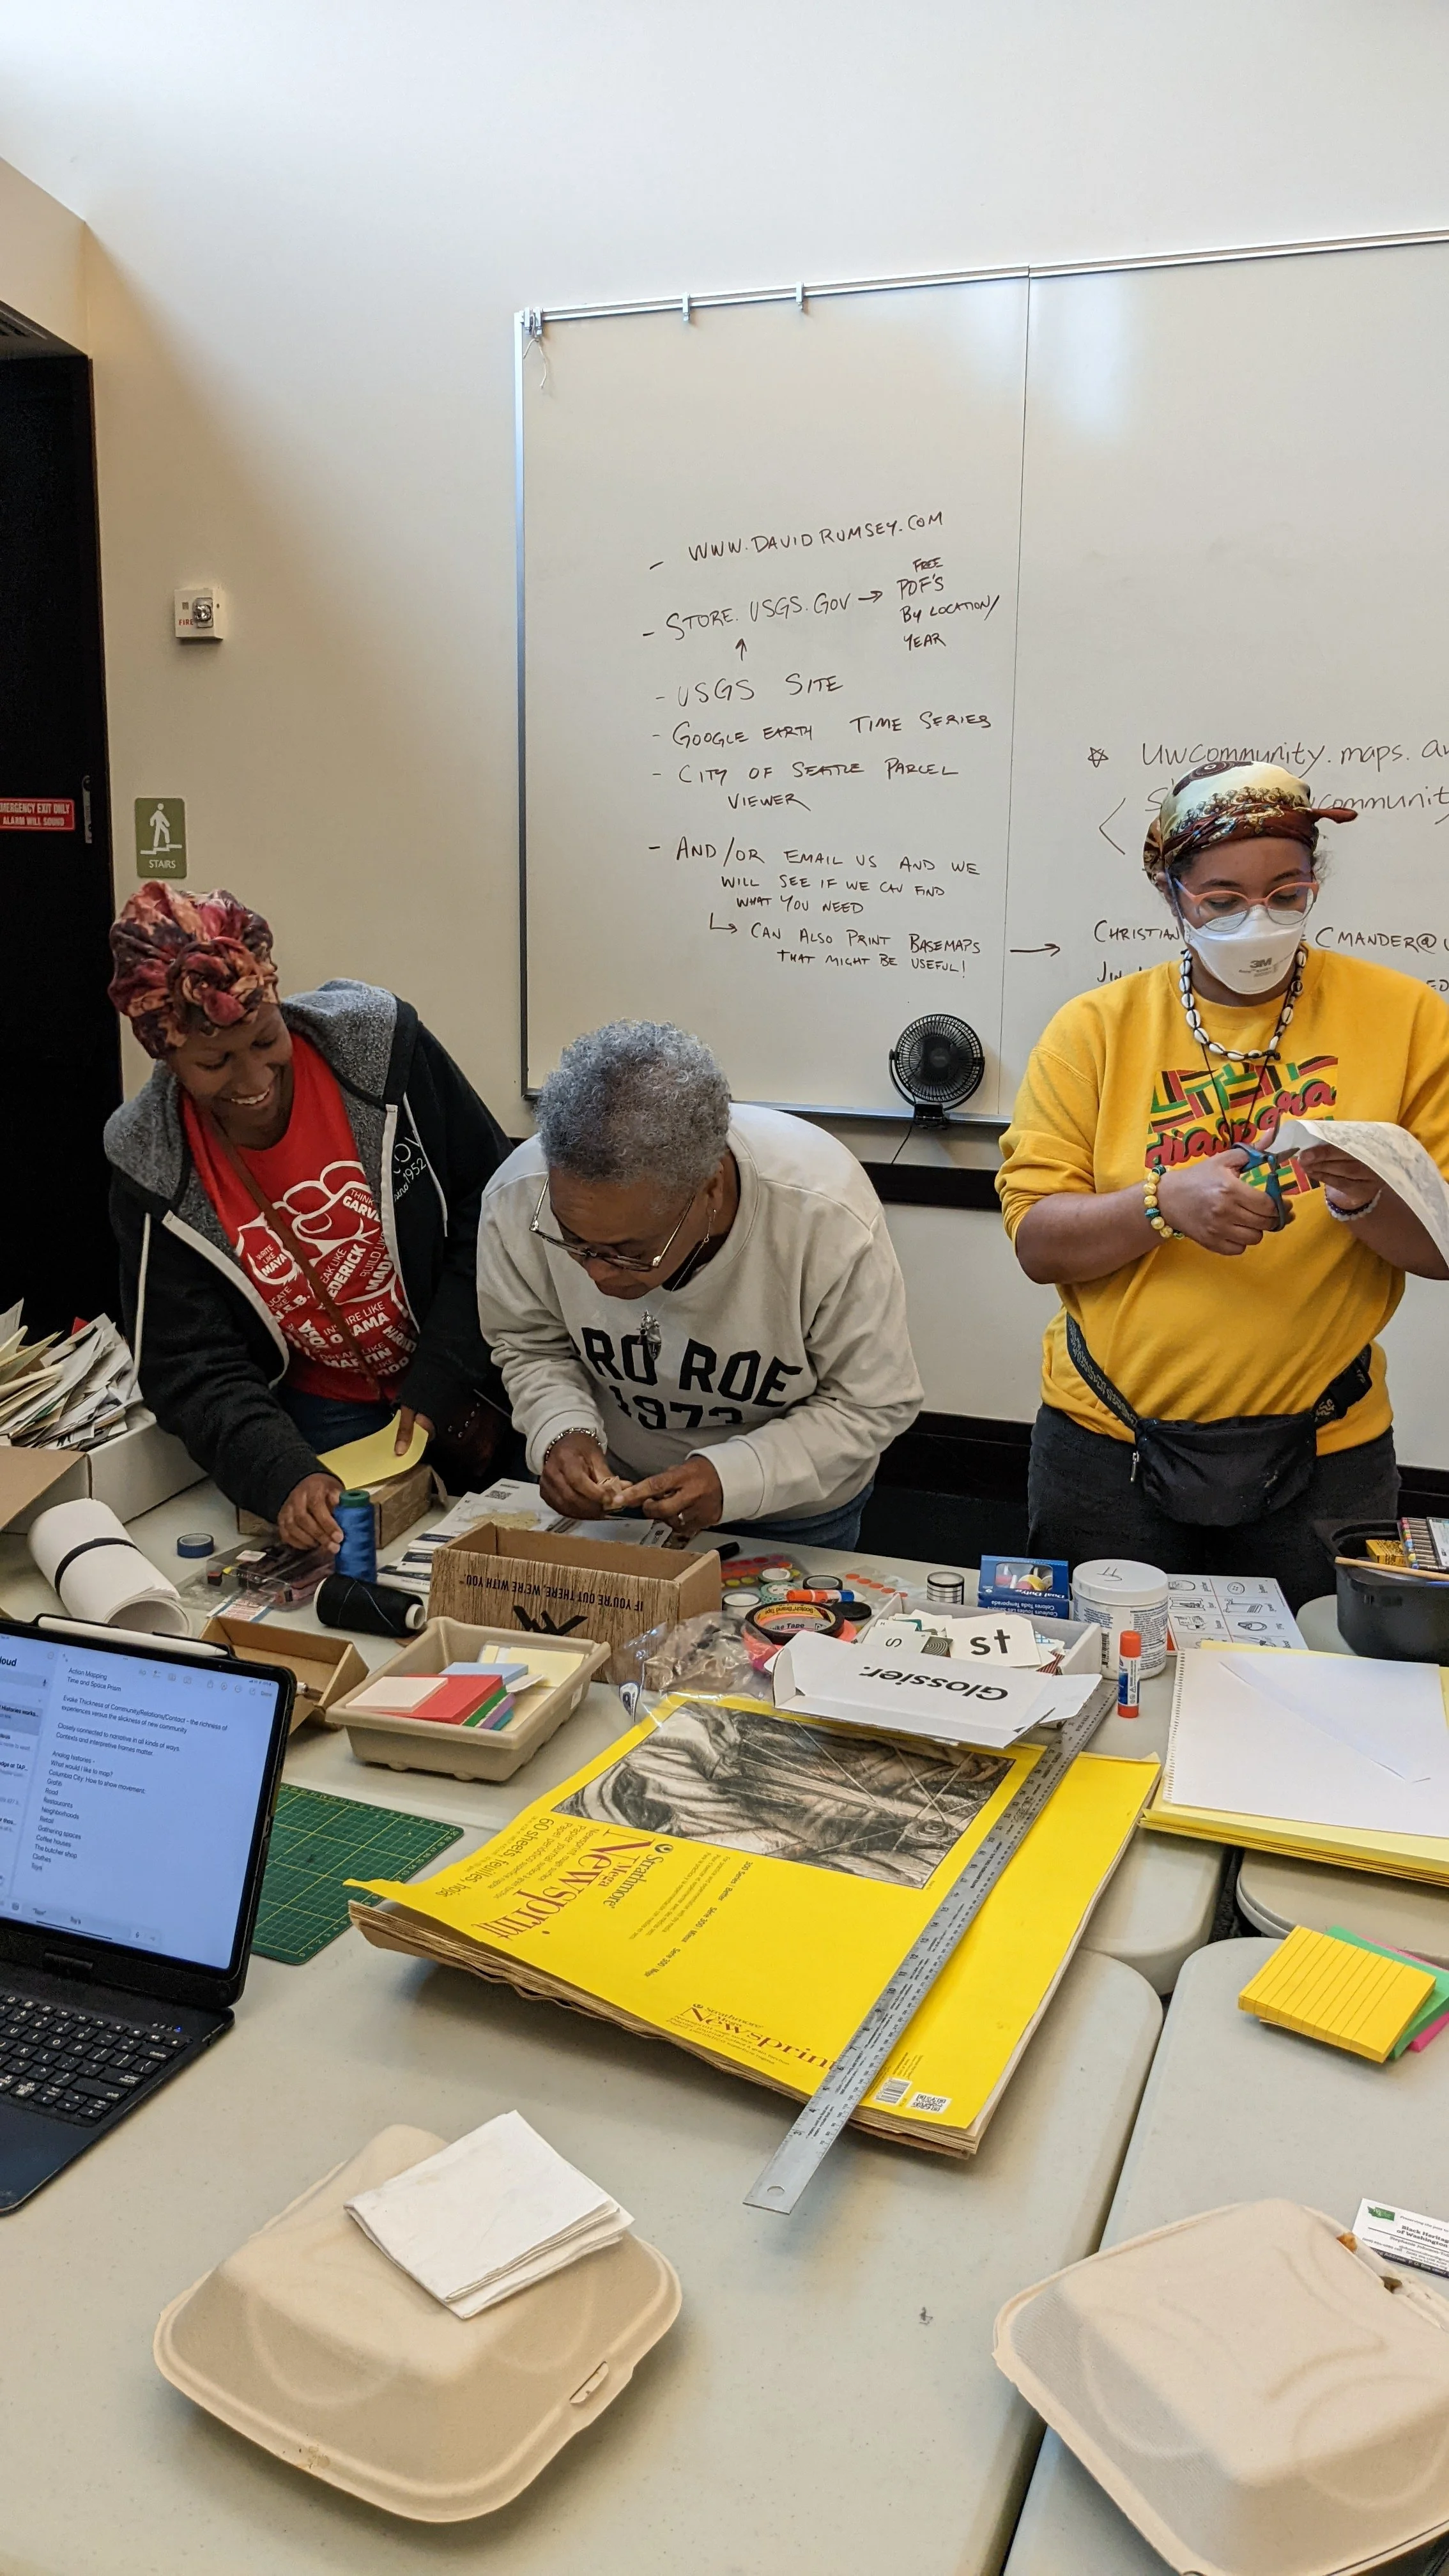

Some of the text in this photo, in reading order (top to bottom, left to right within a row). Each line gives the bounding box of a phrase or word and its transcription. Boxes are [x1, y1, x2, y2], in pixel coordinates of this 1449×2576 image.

[912, 557, 944, 573] FREE
[896, 573, 945, 600] PDF'S
[903, 632, 947, 651] YEAR
[677, 673, 844, 707] USGS SITE
[672, 711, 992, 749] GOOGLE EARTH TIME SERIES
[678, 765, 728, 786] CITY
[749, 766, 773, 779] OF
[884, 757, 958, 779] PARCEL
[0, 802, 35, 813] MERGENCY
[37, 803, 52, 813] EXIT
[728, 793, 811, 811] VIEWER
[3, 816, 64, 826] ALARM WILL SOUND
[149, 860, 176, 869] STAIRS
[676, 836, 981, 875] AND/OR EMAIL US AND WE
[721, 876, 760, 888] WILL
[779, 875, 811, 889] SEE
[820, 878, 838, 890] IF
[847, 880, 870, 891] WE
[736, 894, 864, 914] WHAT YOU NEED
[751, 922, 981, 954] CAN ALSO PRINT BASEMAPS
[777, 949, 965, 978] THAT MIGHT BE USEFUL!
[1250, 958, 1272, 968] 3M
[1145, 1078, 1337, 1169] diaspora
[403, 1158, 426, 1183] 1952
[351, 1189, 374, 1206] THINK
[261, 1253, 287, 1276] MAYA
[334, 1248, 347, 1268] LIKE
[360, 1252, 381, 1278] BUILD
[362, 1301, 386, 1317] LIKE
[571, 1327, 803, 1407] RO ROE
[486, 1577, 509, 1591] WITH
[512, 1581, 540, 1597] WE'RE
[578, 1591, 594, 1604] OUT
[598, 1594, 631, 1609] YOU'RE
[634, 1601, 643, 1611] IF
[969, 1629, 1011, 1656] st
[68, 1667, 107, 1681] Action Mapping
[67, 1676, 79, 1685] Time
[90, 1682, 106, 1692] Space
[859, 1666, 1008, 1701] Glossier.
[79, 1698, 103, 1708] Thickness
[62, 1705, 91, 1716] experiences
[91, 1711, 108, 1720] versus
[159, 1722, 188, 1734] community
[56, 1731, 78, 1742] Contexts
[57, 1722, 76, 1733] Closely
[77, 1726, 103, 1737] connected
[145, 1738, 158, 1749] kinds
[52, 1751, 70, 1761] Analog
[50, 1759, 64, 1768] What
[65, 1763, 80, 1772] would
[100, 1770, 113, 1779] map?
[85, 1776, 97, 1784] How
[103, 1780, 118, 1789] show
[34, 1843, 44, 1852] The
[435, 1818, 555, 1898] 60 hojas
[598, 1862, 631, 1887] Mega
[471, 1828, 656, 1942] Newsprint
[1402, 2225, 1421, 2235] Black
[1406, 2231, 1448, 2249] Washington
